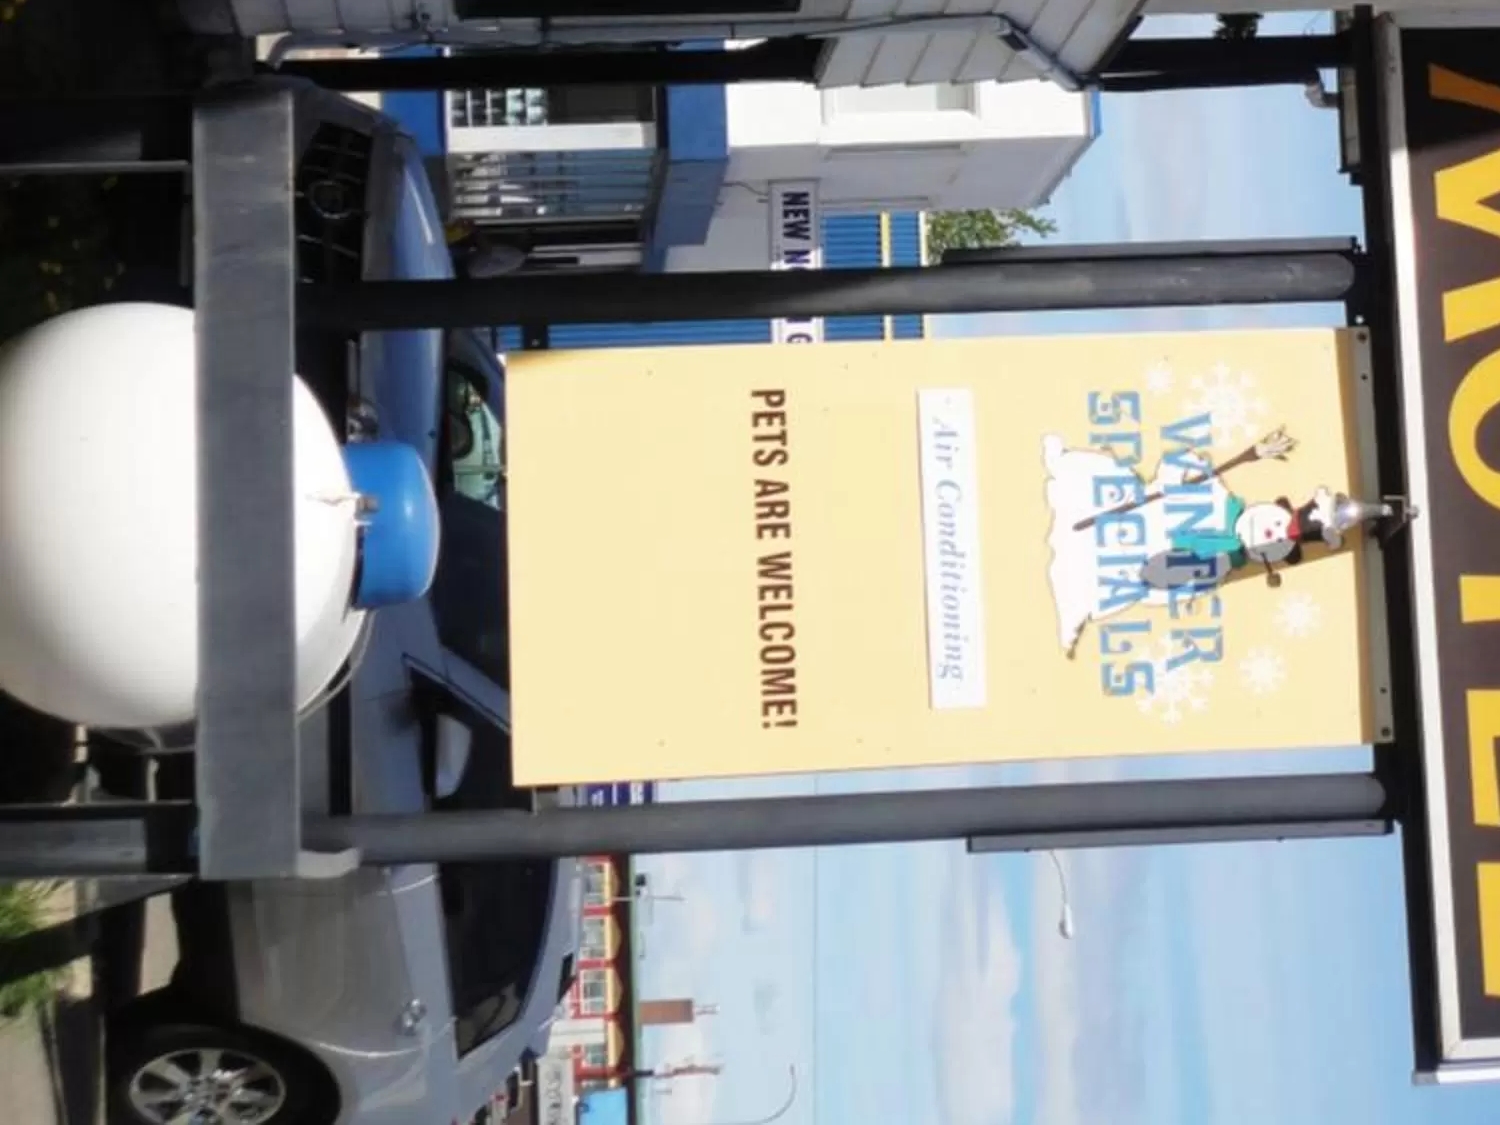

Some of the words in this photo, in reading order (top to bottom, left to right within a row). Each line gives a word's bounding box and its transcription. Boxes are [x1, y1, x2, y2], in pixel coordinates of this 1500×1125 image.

[782, 191, 811, 240] NEW
[751, 389, 789, 467] PETS
[932, 417, 960, 470] Air
[754, 479, 792, 540] ARE
[1087, 390, 1155, 698] SPECIALS
[1160, 412, 1224, 672] WINTER
[757, 551, 799, 730] WELCOME!
[934, 479, 969, 682] Conditioning
